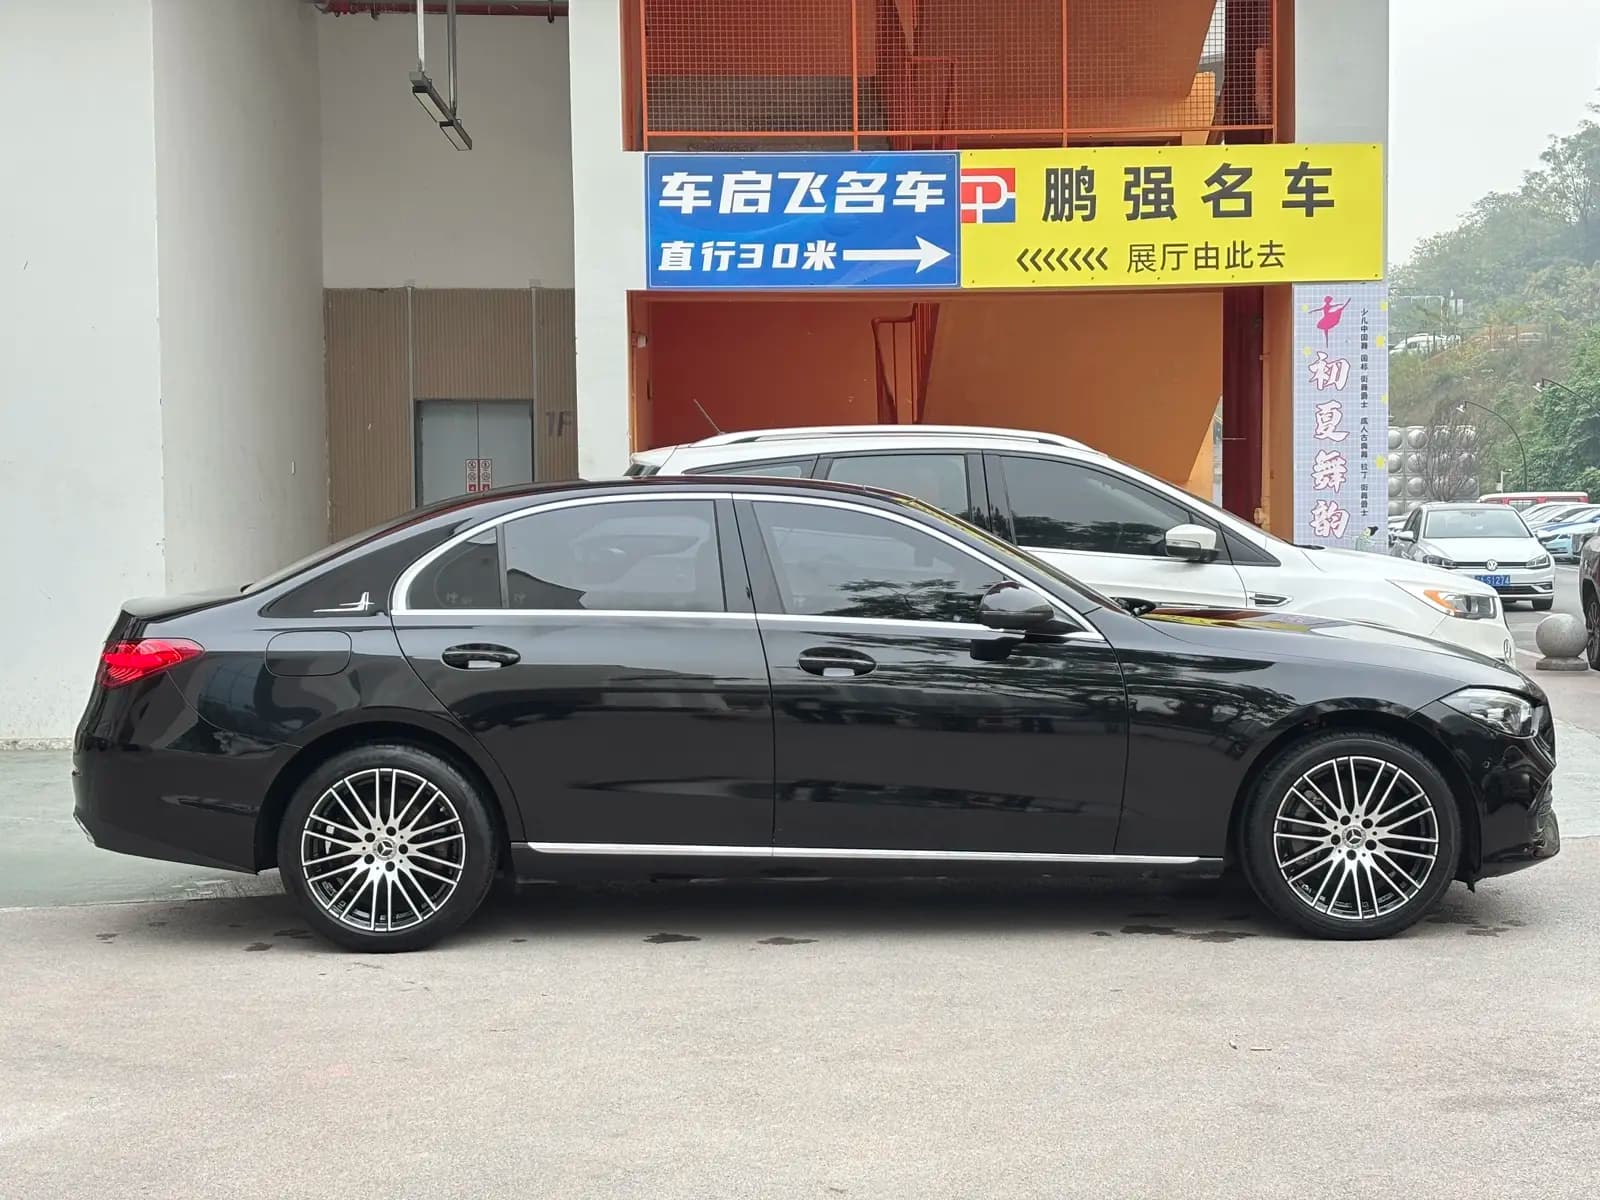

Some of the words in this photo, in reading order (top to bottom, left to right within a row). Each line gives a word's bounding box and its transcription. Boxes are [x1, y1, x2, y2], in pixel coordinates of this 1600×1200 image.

[659, 170, 947, 214] 车启飞名车
[1042, 162, 1335, 223] 鹏强名车
[658, 240, 837, 271] 直行30米
[1126, 239, 1286, 273] 展厅由此去
[1308, 351, 1351, 538] 初夏舞韵
